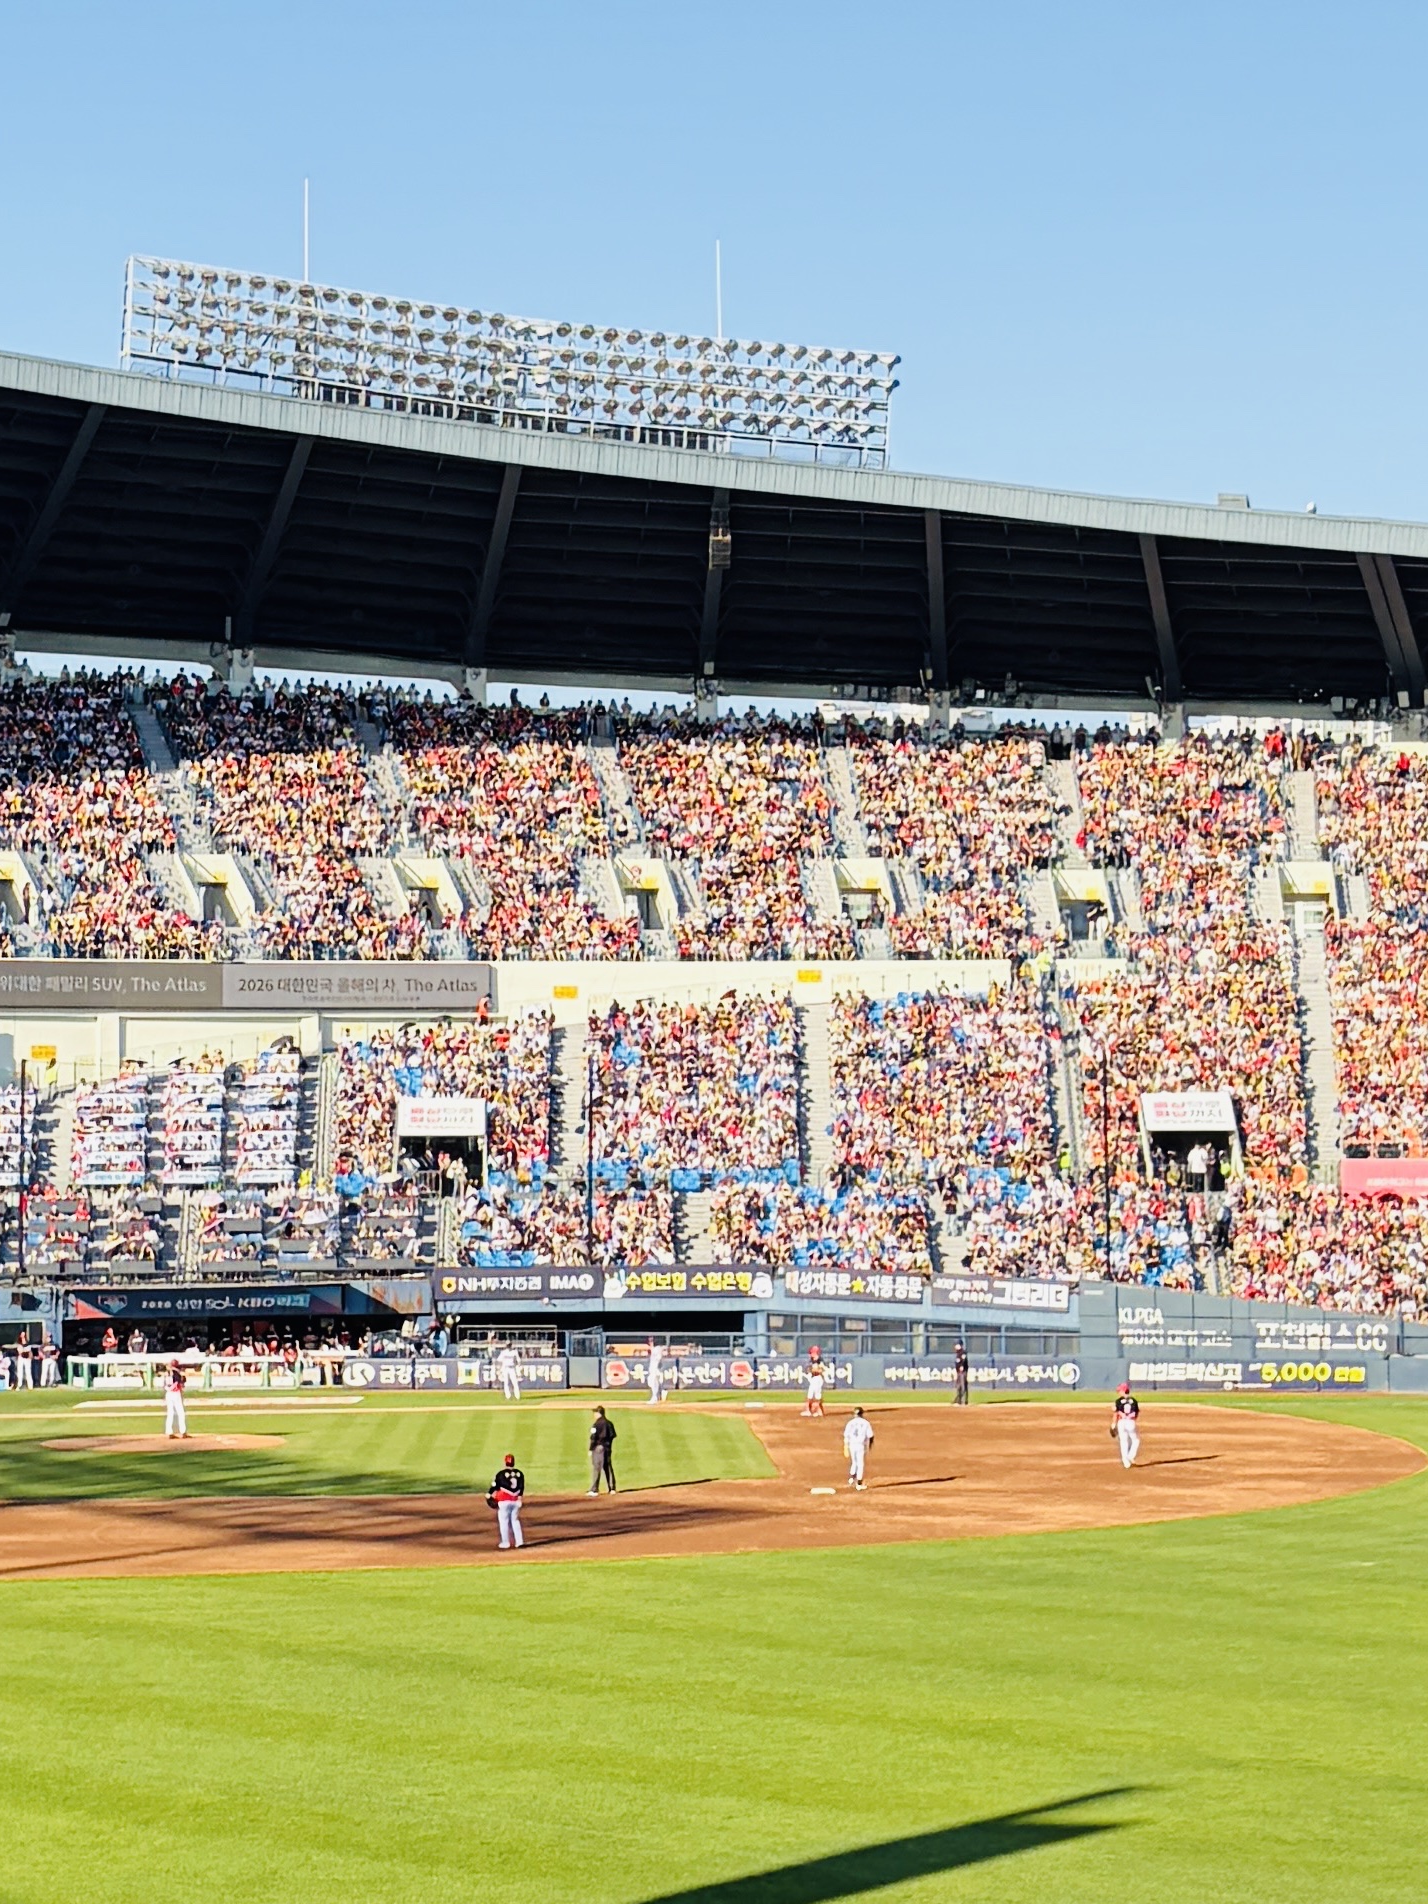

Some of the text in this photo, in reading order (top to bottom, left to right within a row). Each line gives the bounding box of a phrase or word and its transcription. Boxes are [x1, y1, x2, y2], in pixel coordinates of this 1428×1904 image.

[0, 975, 42, 993] 위대한
[131, 976, 160, 992] The
[164, 976, 208, 992] Atlas
[238, 978, 274, 993] 2026
[277, 977, 333, 994] 대한민국
[404, 977, 434, 993] The
[438, 977, 478, 993] Atlas
[1118, 1307, 1164, 1326] KLPGA
[379, 1364, 447, 1384] 금강주택
[1261, 1361, 1332, 1383] 5,000
